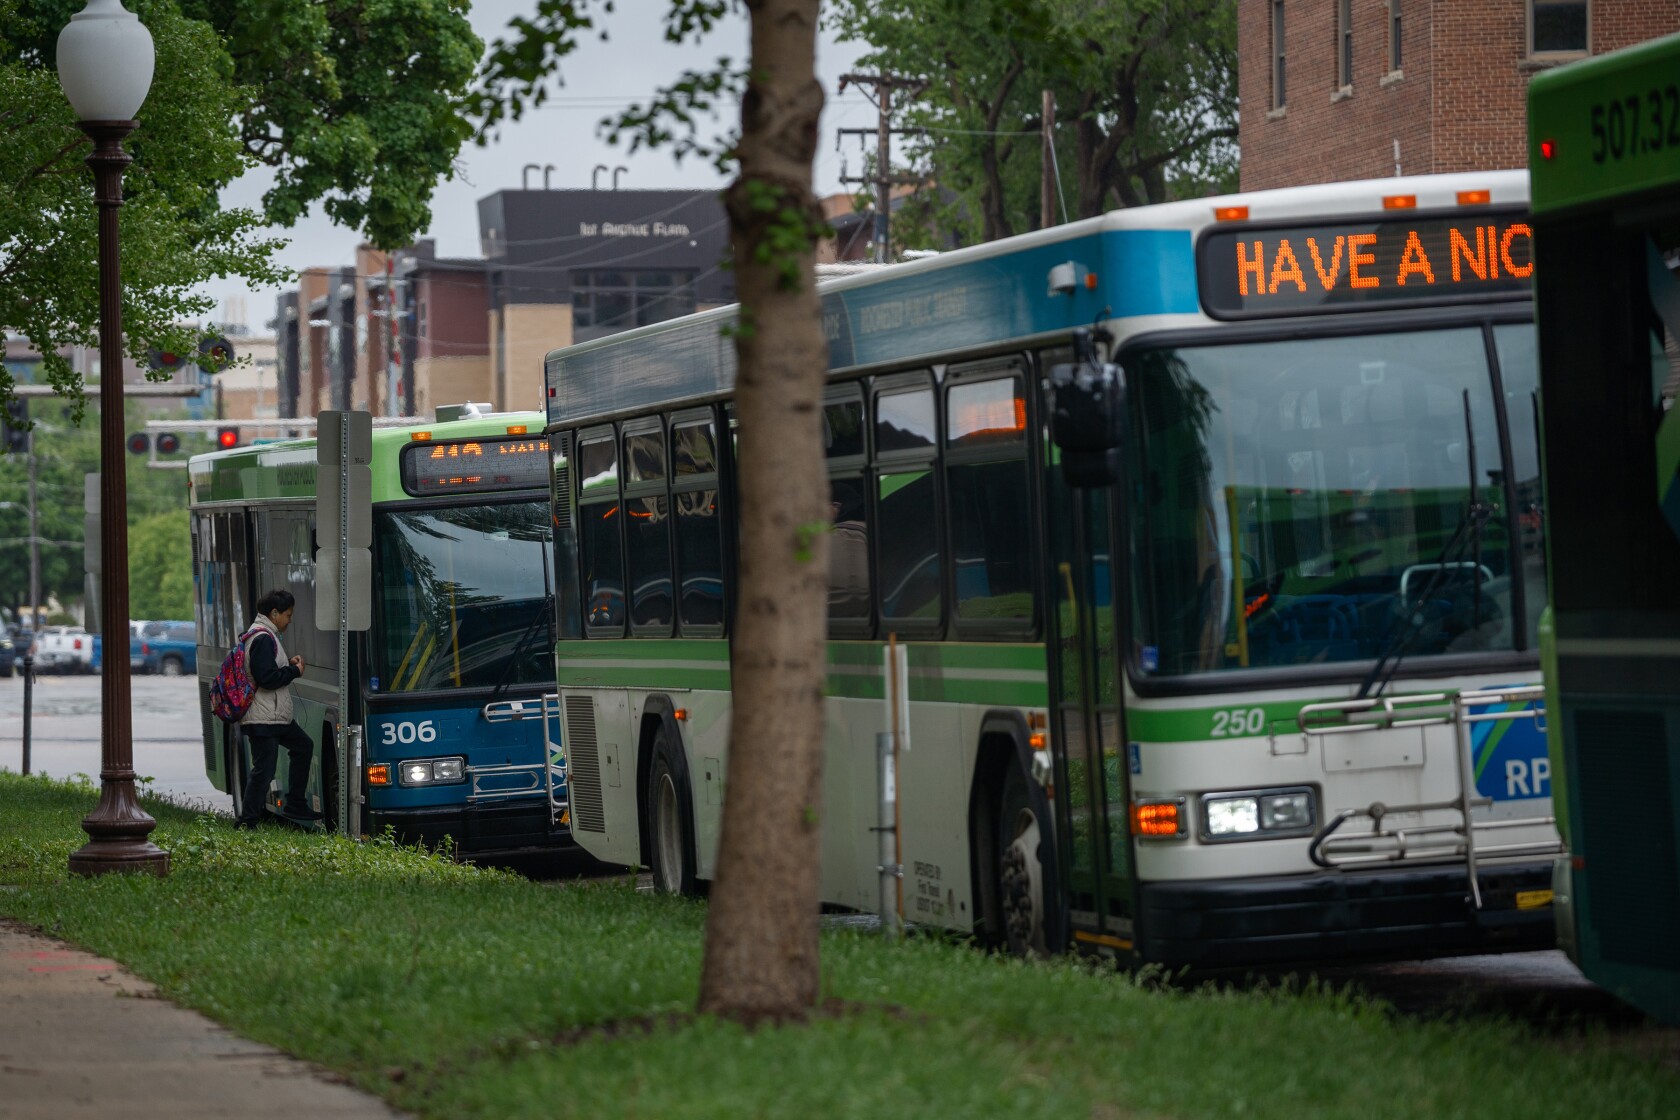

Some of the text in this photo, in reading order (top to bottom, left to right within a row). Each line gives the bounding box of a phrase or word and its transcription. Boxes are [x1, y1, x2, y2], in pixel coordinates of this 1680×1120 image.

[1236, 223, 1534, 296] HAVE A NIC
[381, 720, 436, 745] 306
[1210, 708, 1265, 737] 250
[1505, 757, 1551, 796] RP
